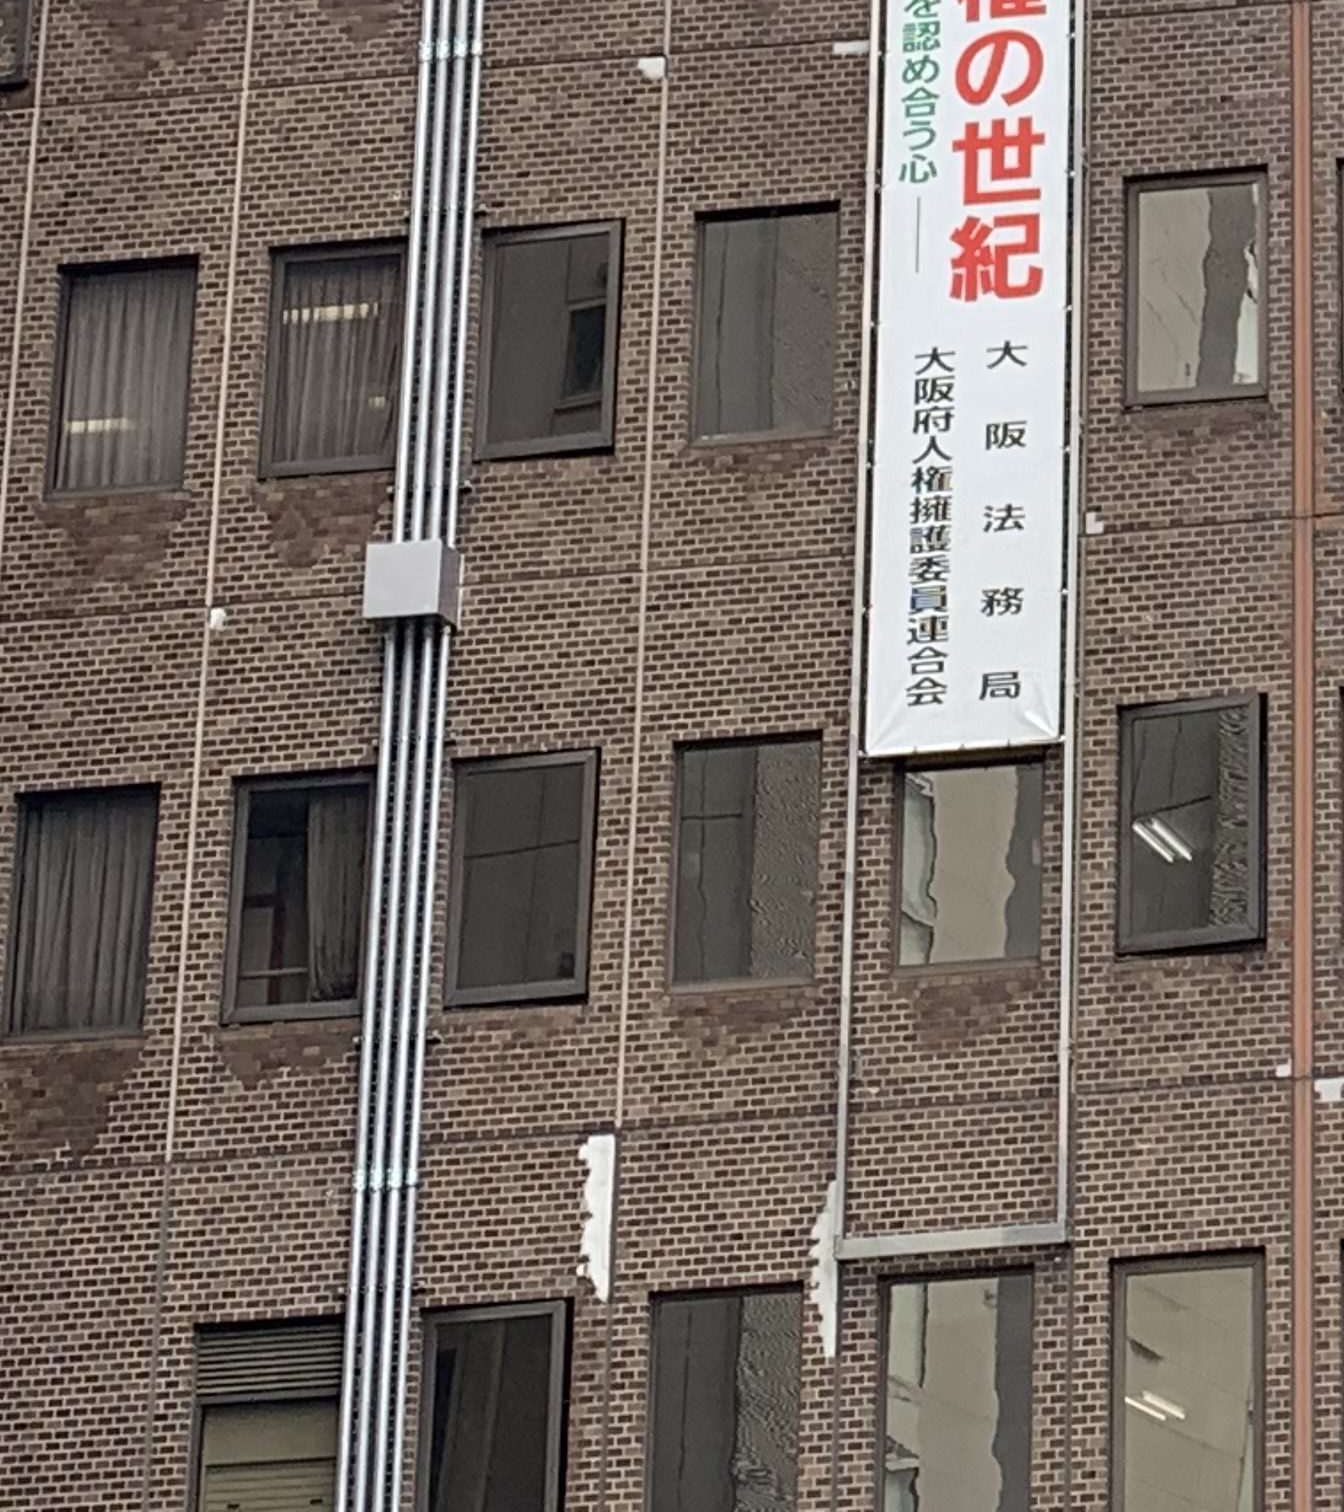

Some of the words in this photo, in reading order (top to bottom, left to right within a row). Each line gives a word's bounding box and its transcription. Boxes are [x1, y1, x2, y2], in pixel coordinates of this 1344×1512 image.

[906, 346, 956, 707] 大阪府人権擁護委員連合会
[979, 339, 1028, 701] 大阪法務局
